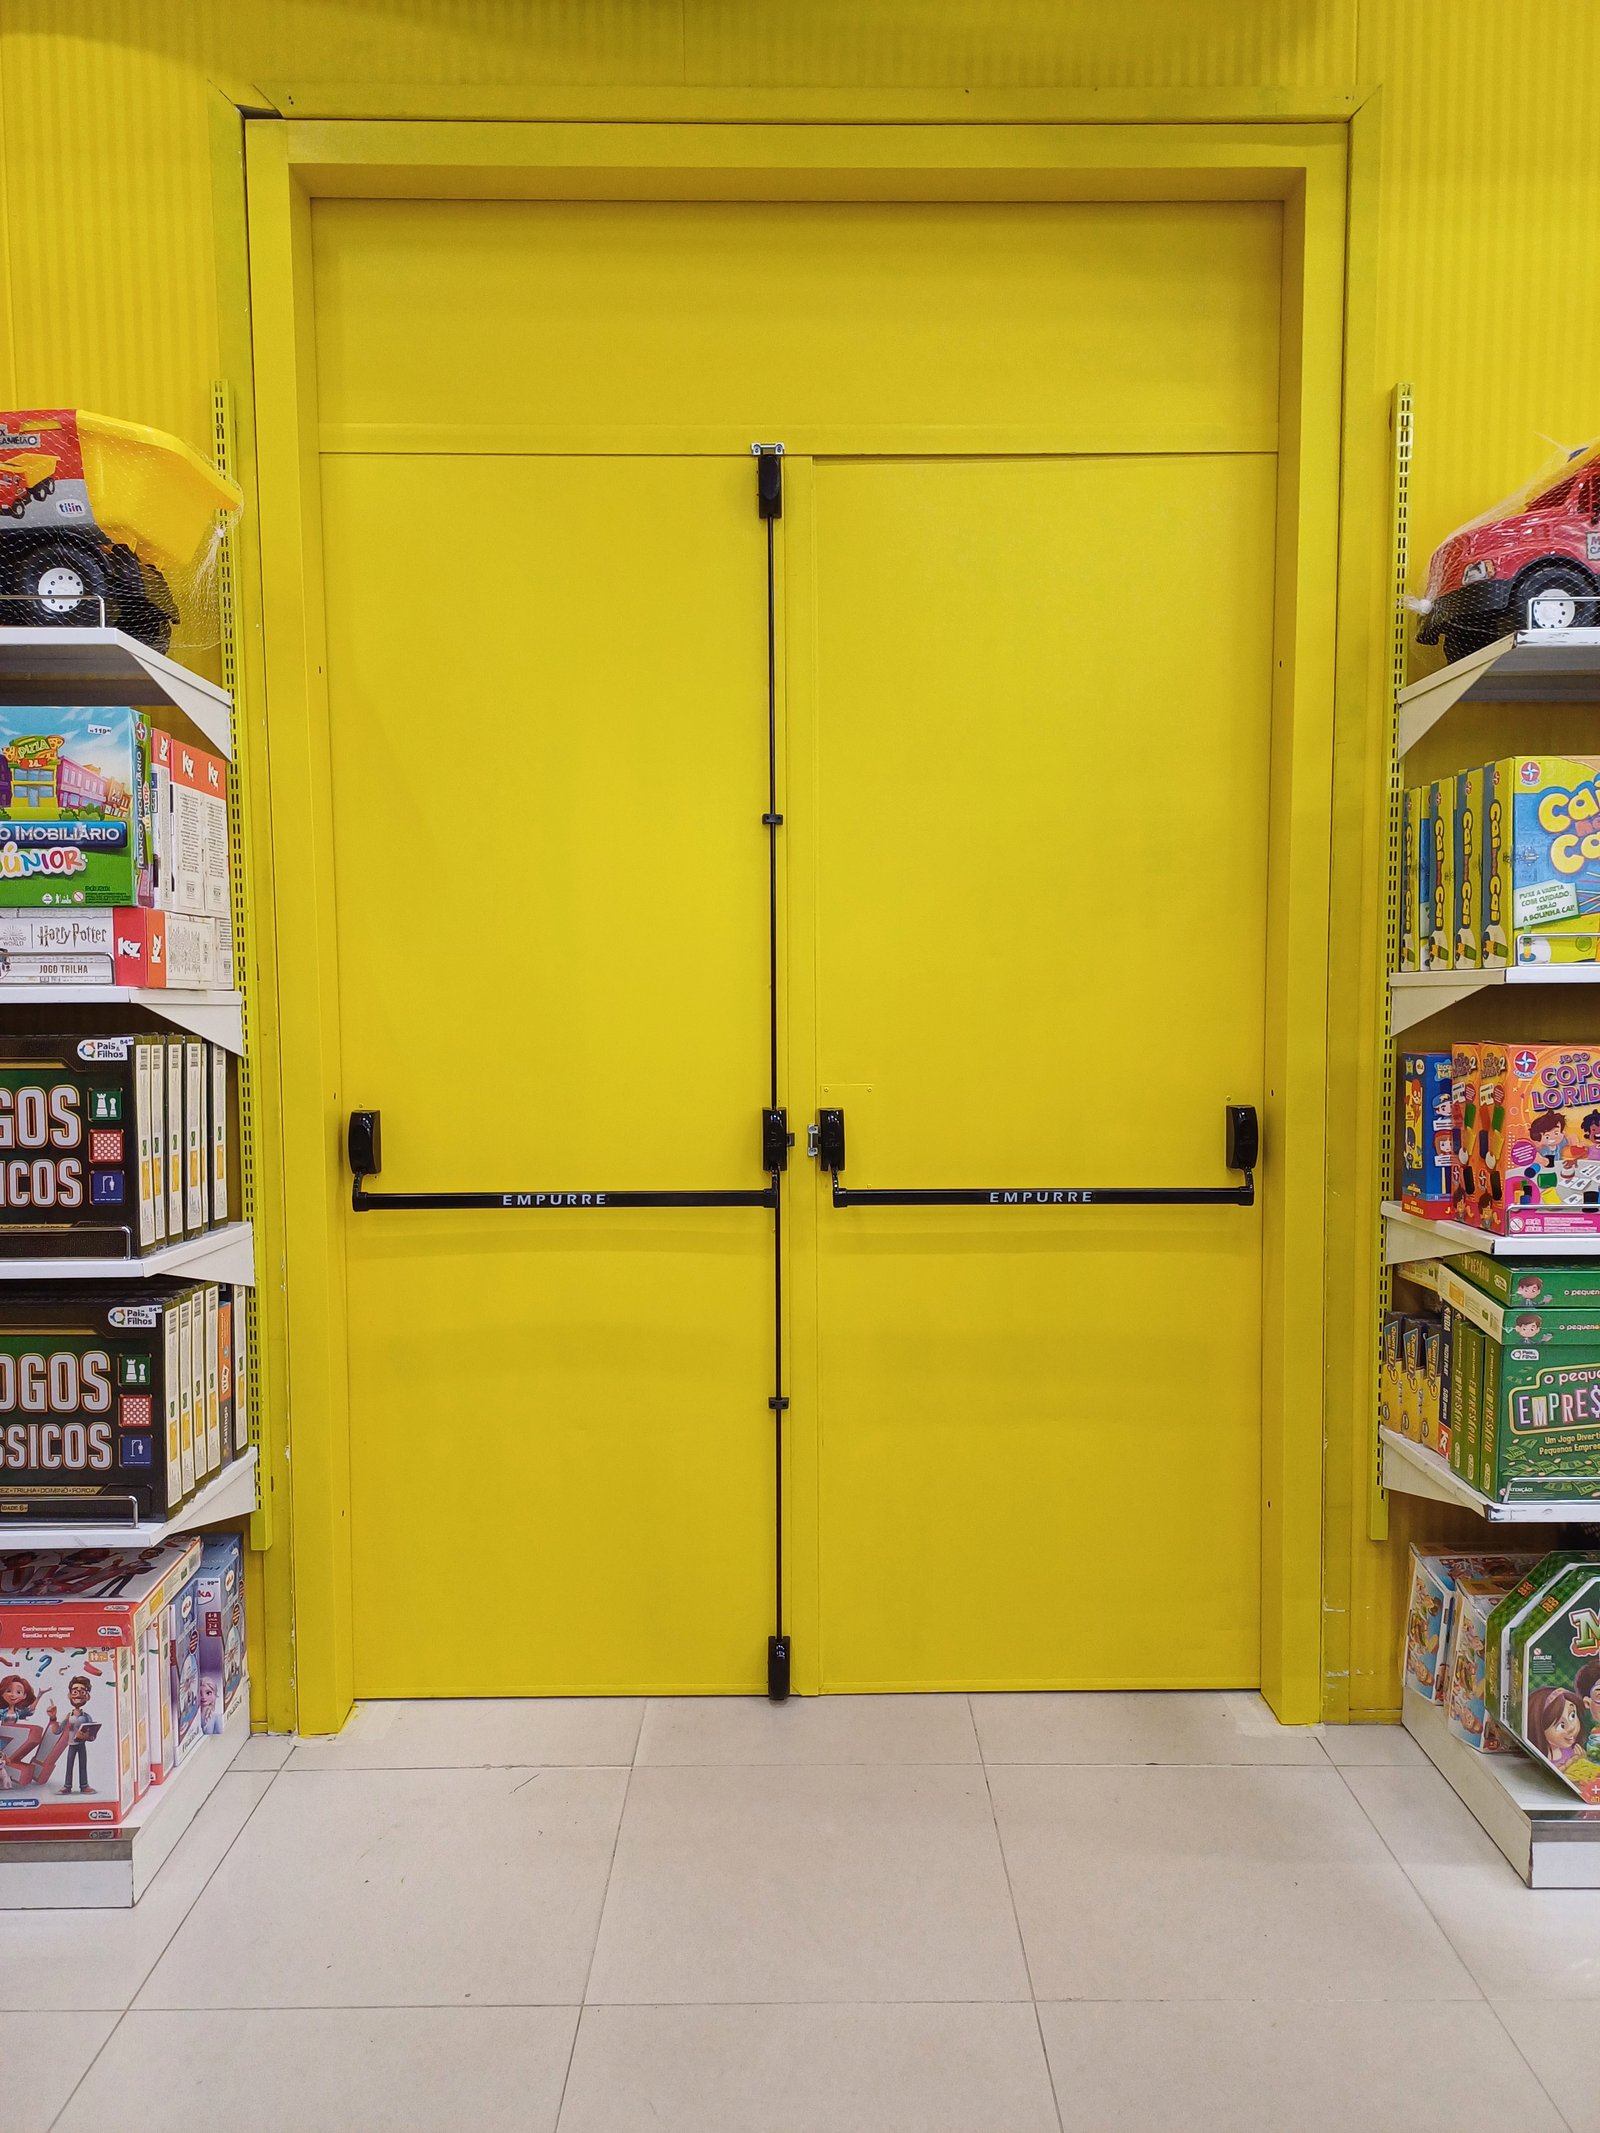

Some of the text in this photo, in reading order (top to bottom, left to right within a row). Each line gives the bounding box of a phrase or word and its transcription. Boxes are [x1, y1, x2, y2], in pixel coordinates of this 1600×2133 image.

[59, 502, 82, 512] tilin
[18, 739, 50, 758] PIZZA
[15, 824, 120, 841] IMOBILIÁRIO
[0, 843, 83, 873] ÚNIOR
[37, 923, 107, 948] Harry Potter
[39, 964, 88, 974] JOGO TRILHA
[97, 1042, 115, 1050] Pais
[97, 1050, 124, 1058] Filhos
[502, 1193, 607, 1206] EMPURRE
[989, 1191, 1092, 1204] EMPURRE
[127, 1309, 145, 1317] Pais
[127, 1317, 153, 1325] Filhos
[1544, 1436, 1557, 1445] Um
[1558, 1434, 1576, 1445] Jogo
[0, 1421, 113, 1471] SICOS
[1539, 1446, 1573, 1457] Pequenos
